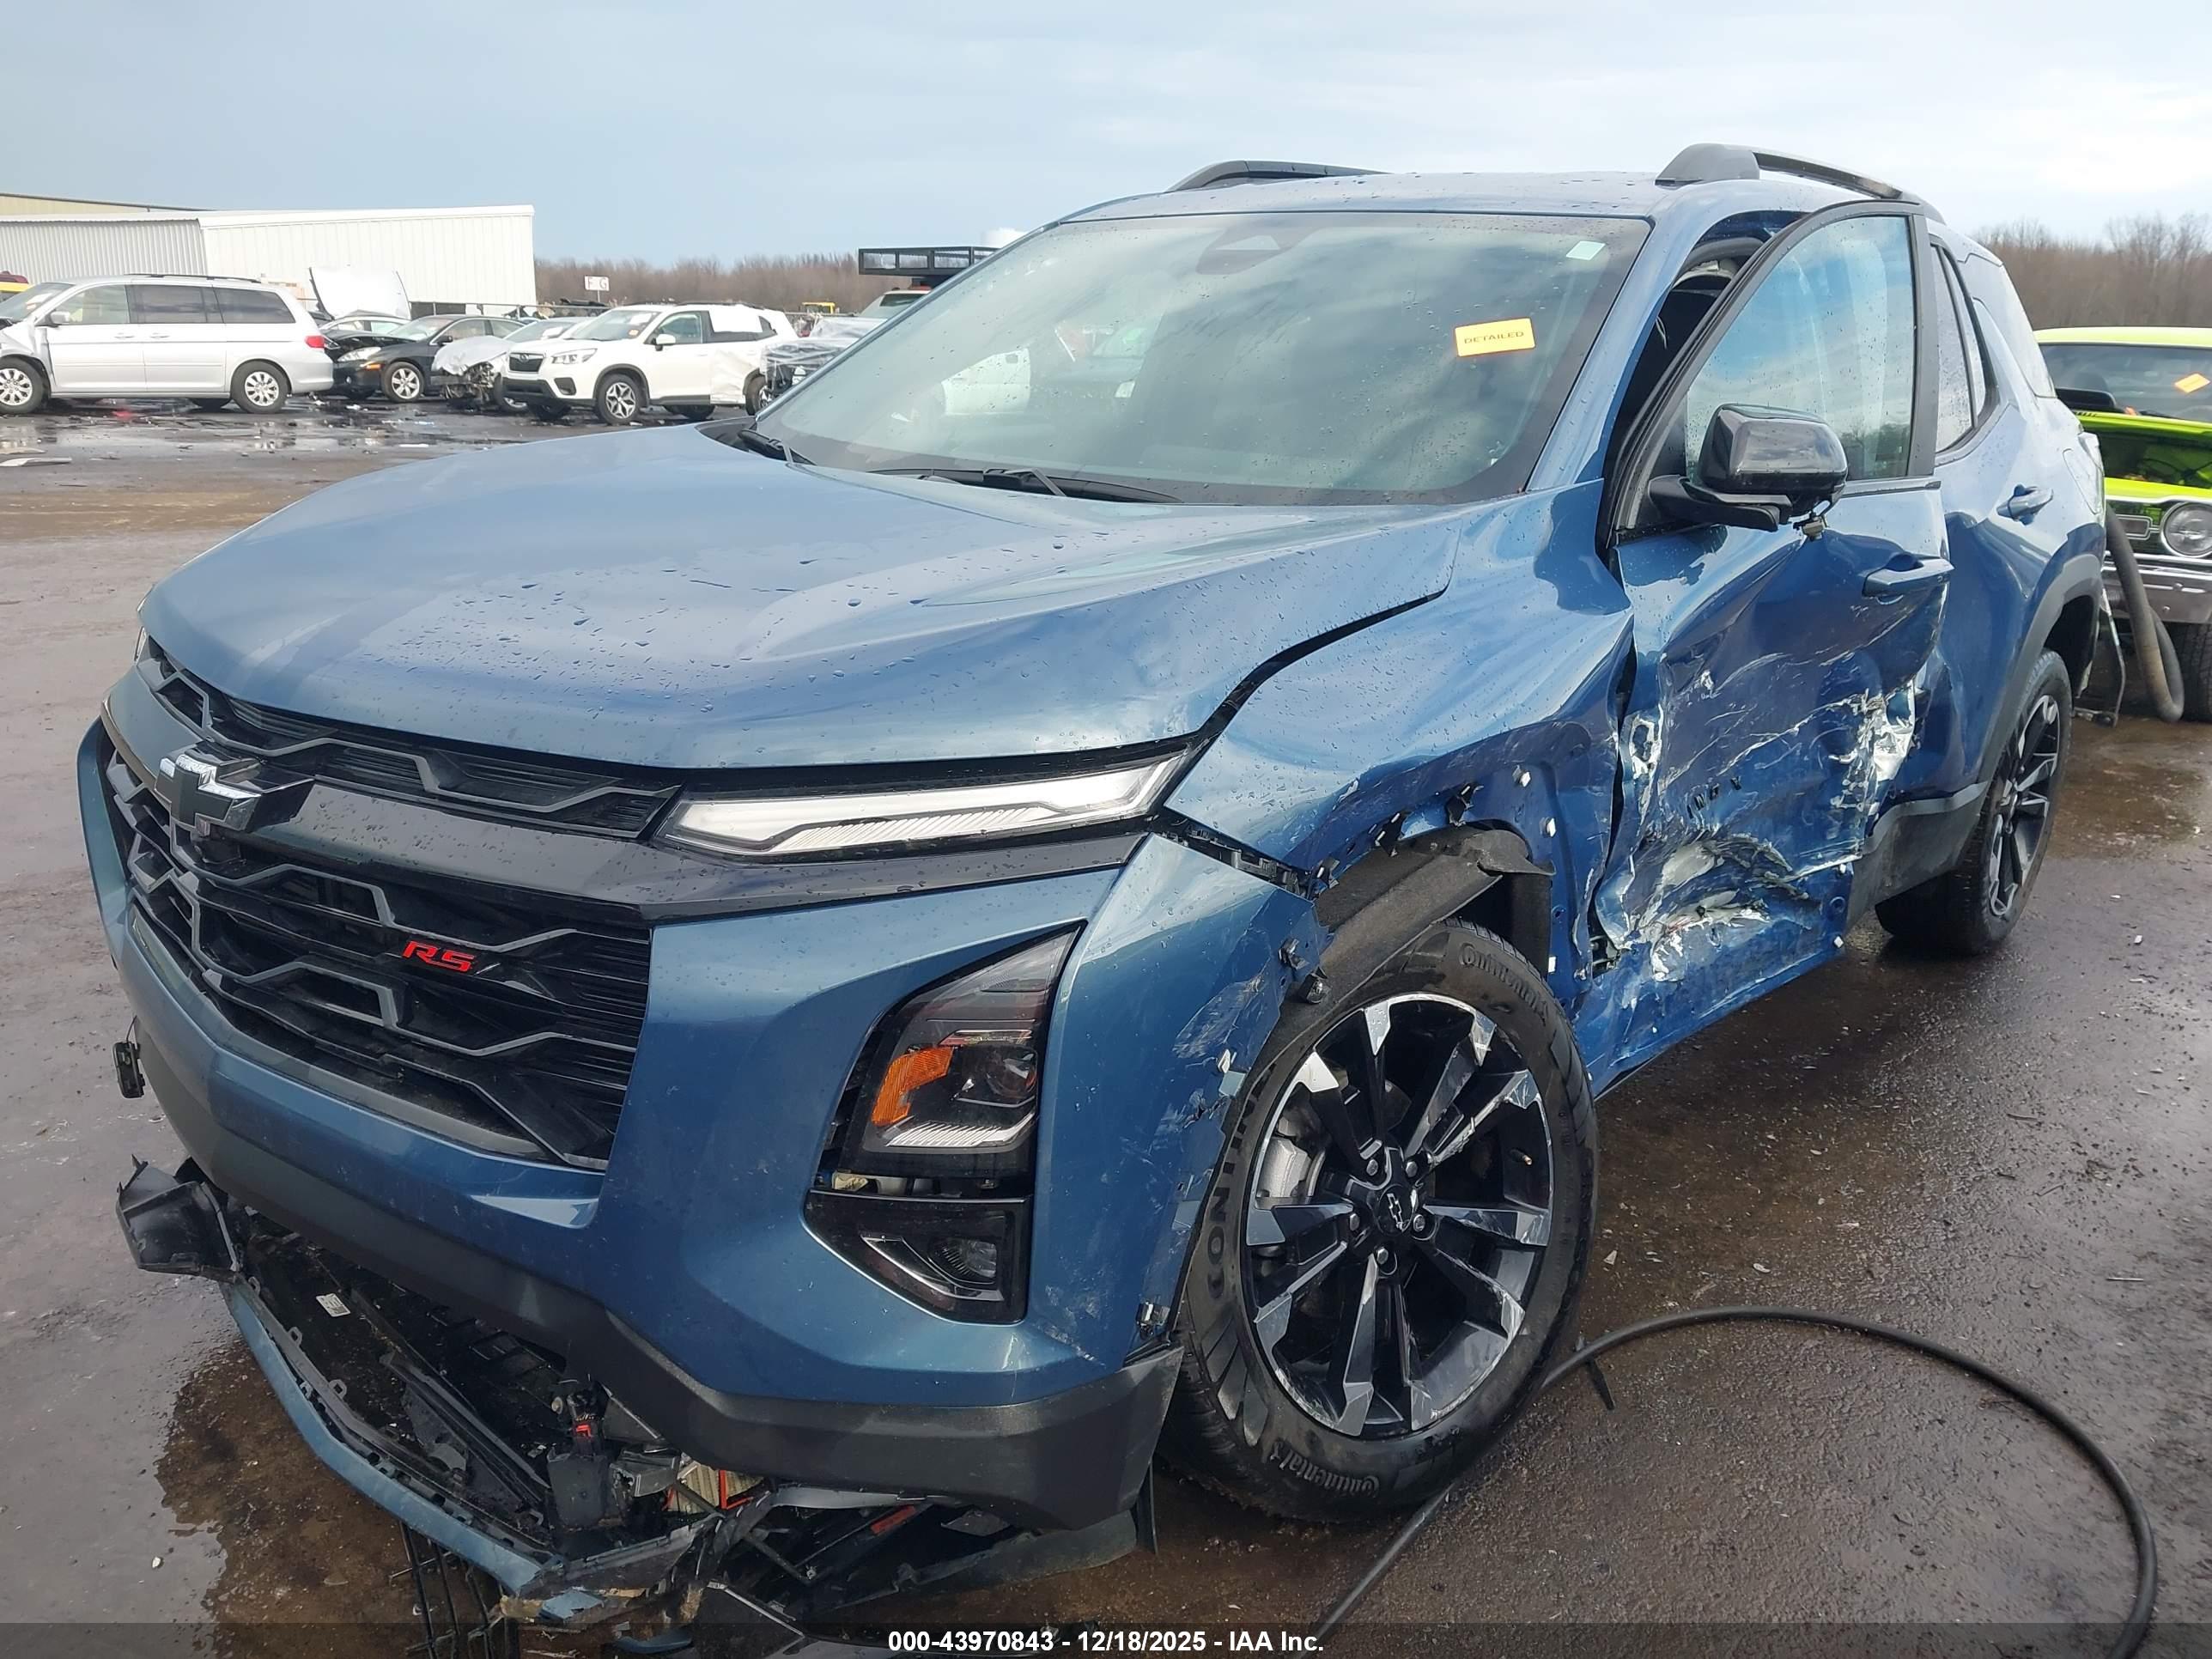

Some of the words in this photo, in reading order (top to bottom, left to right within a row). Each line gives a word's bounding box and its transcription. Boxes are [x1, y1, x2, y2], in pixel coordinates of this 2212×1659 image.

[1463, 331, 1525, 343] DETAILED
[402, 940, 475, 972] RS
[1460, 942, 1541, 1013] Continental
[1279, 1447, 1381, 1498] Continental
